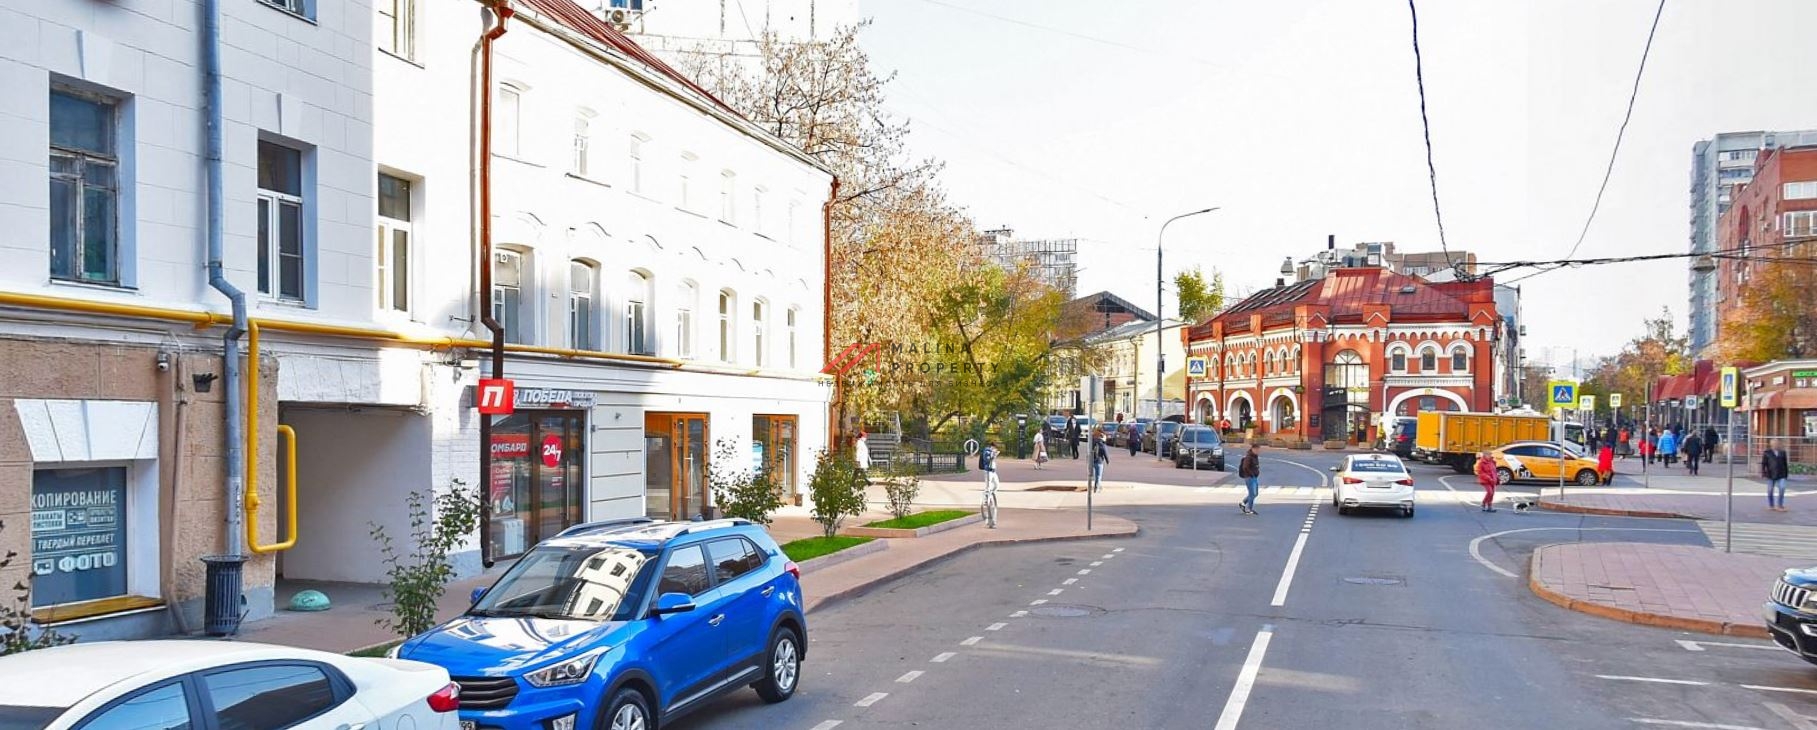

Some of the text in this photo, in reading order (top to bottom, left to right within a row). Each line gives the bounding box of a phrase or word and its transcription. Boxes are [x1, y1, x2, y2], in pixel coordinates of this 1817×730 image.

[482, 386, 505, 408] П
[523, 389, 573, 403] ПОБЕДА
[491, 442, 527, 453] ОМБАРД
[543, 444, 562, 462] 24/7
[38, 533, 76, 550] ТВЕРДЫЙ
[59, 551, 117, 573] ФОТО
